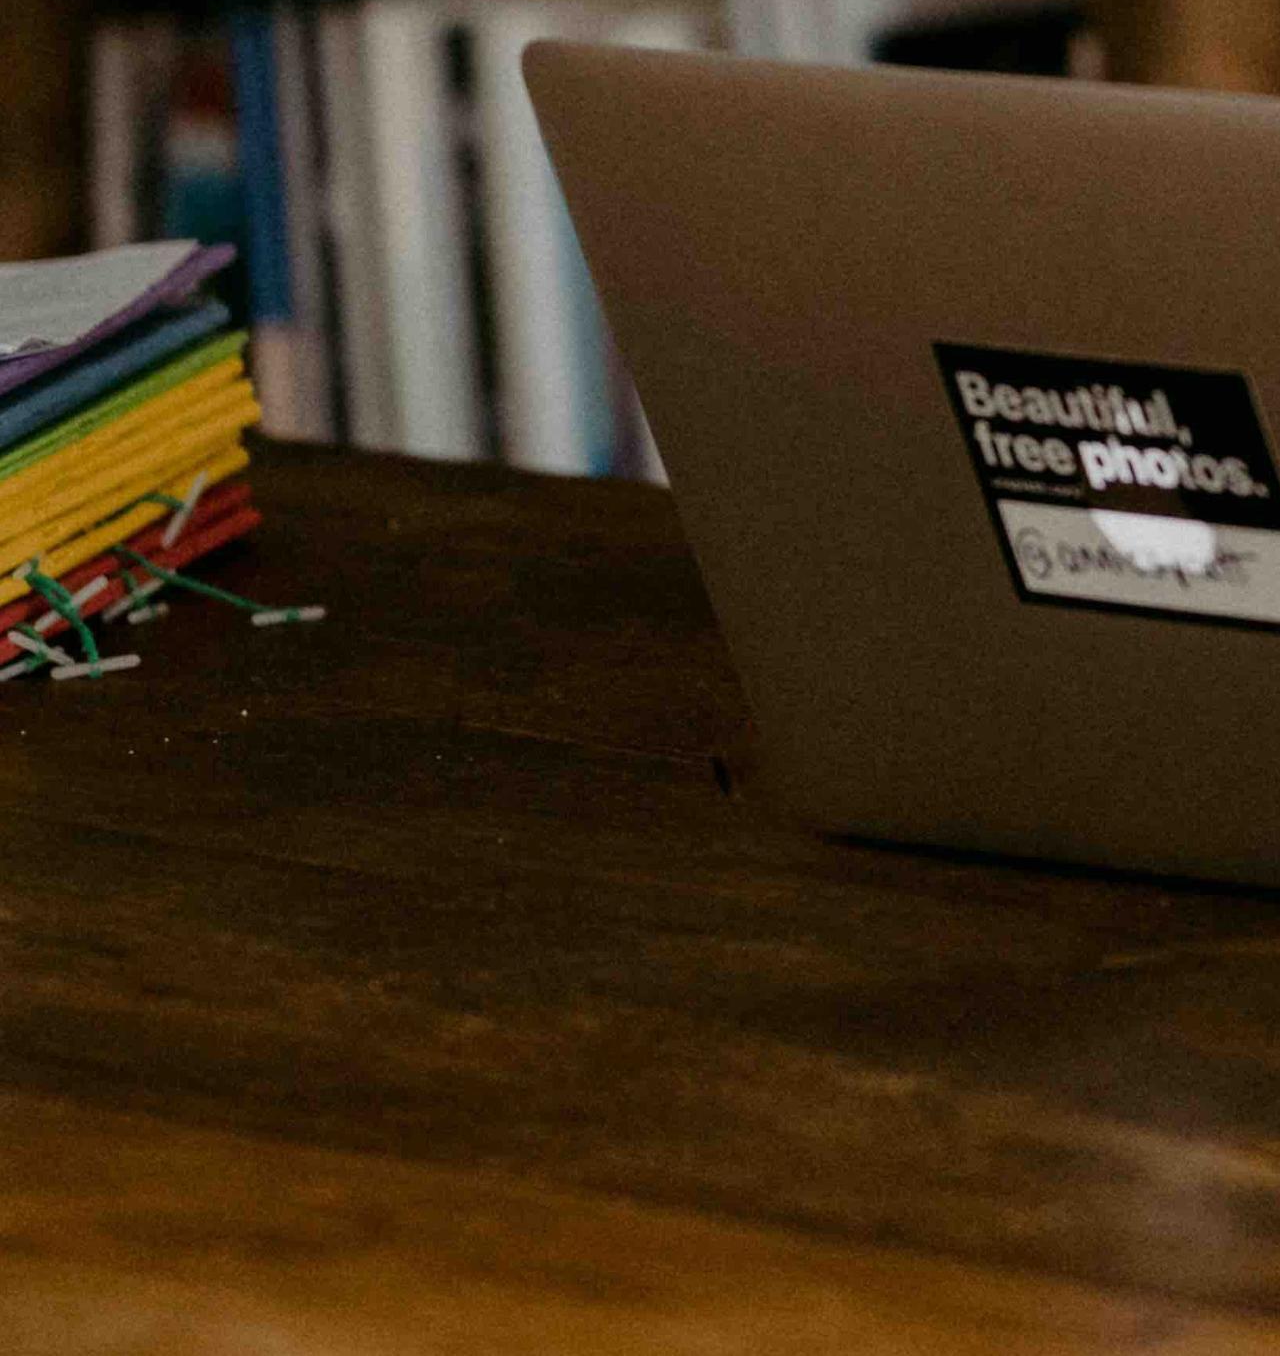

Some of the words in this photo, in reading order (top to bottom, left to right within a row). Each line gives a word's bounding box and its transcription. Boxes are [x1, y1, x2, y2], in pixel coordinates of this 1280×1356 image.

[955, 370, 1192, 447] Beautiful,
[973, 422, 1077, 476] free
[1079, 436, 1270, 498] photos.
